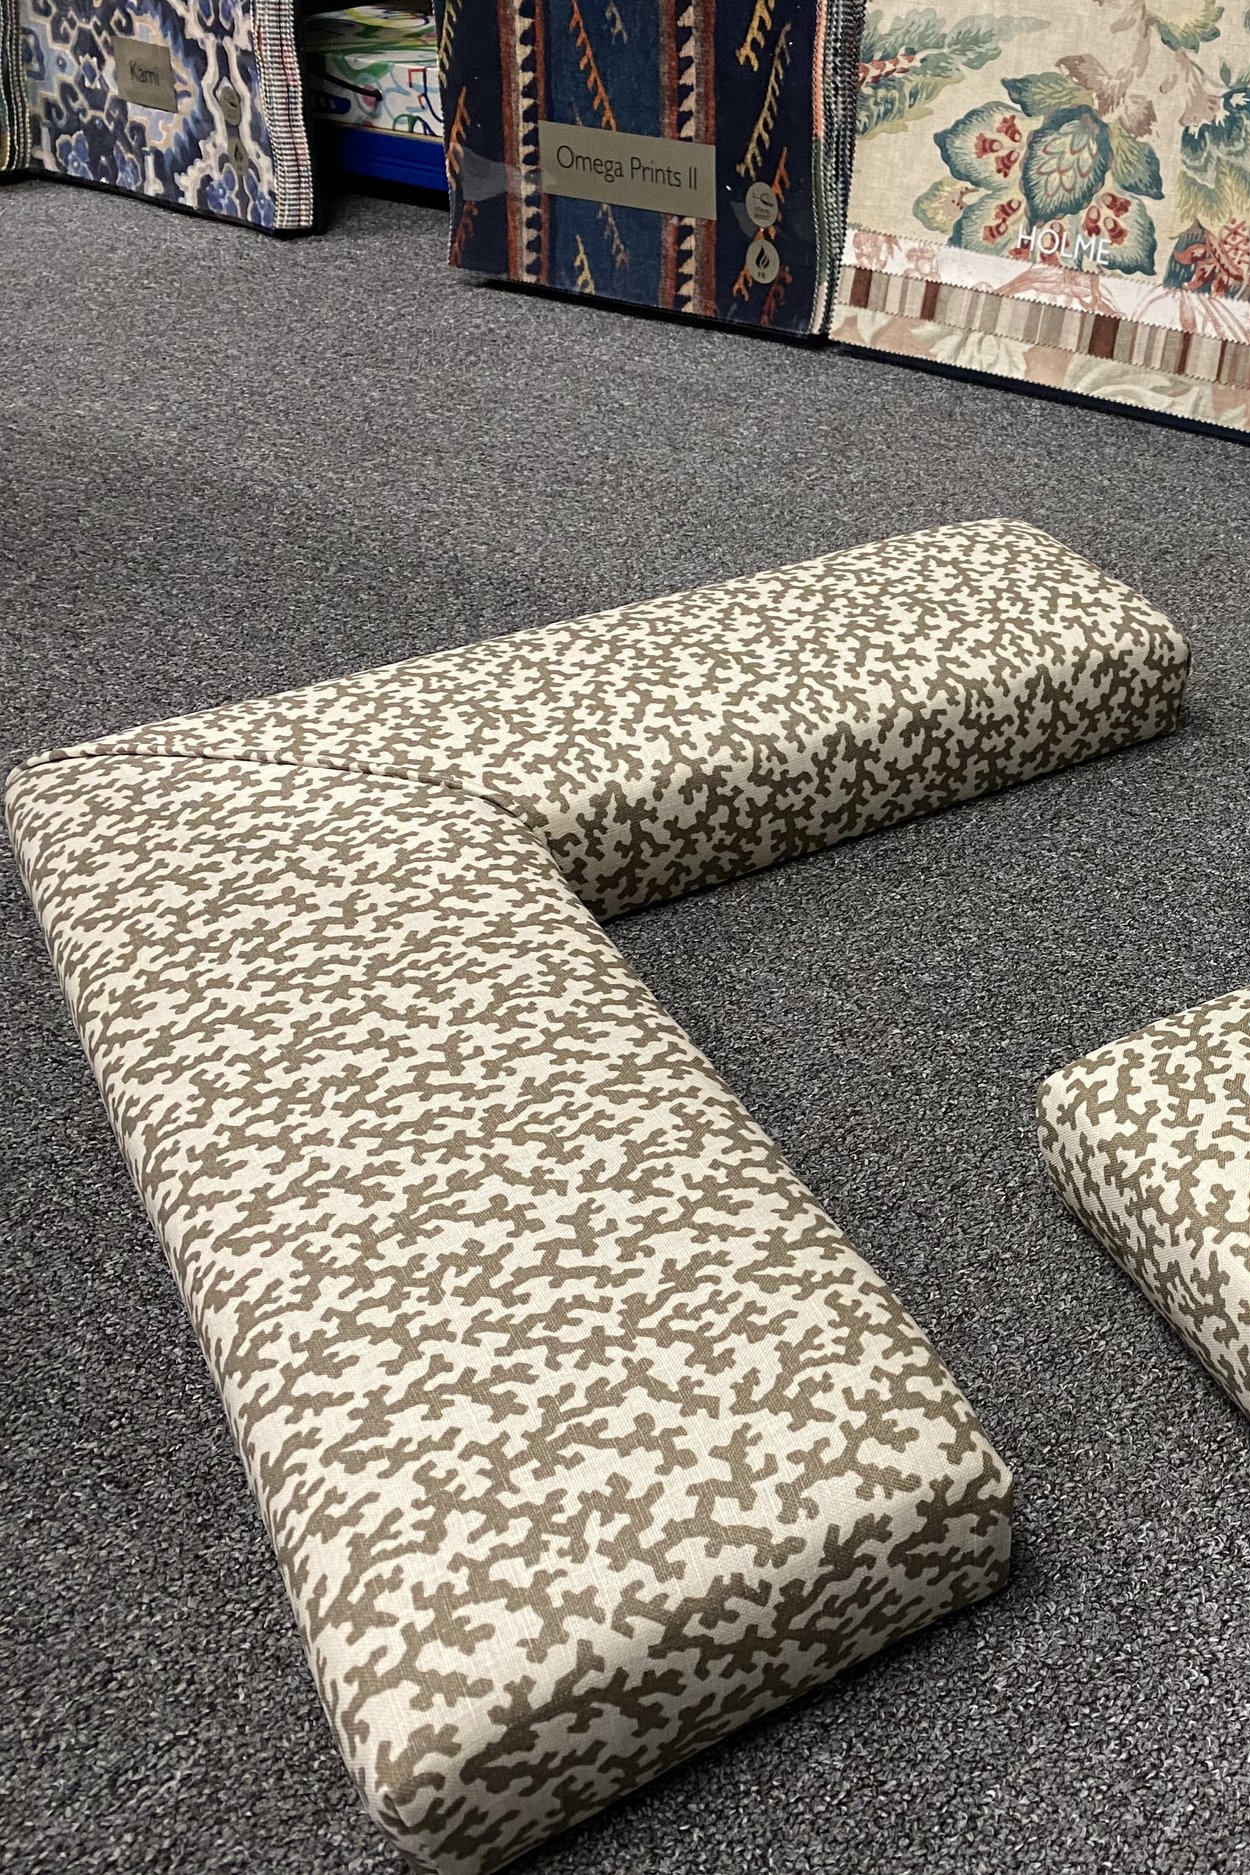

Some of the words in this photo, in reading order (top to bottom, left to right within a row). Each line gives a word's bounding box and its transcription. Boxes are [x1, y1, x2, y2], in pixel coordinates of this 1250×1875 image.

[129, 61, 160, 86] Kami
[556, 145, 624, 183] Omega
[631, 156, 682, 188] Prints
[1016, 224, 1112, 265] HOLME
